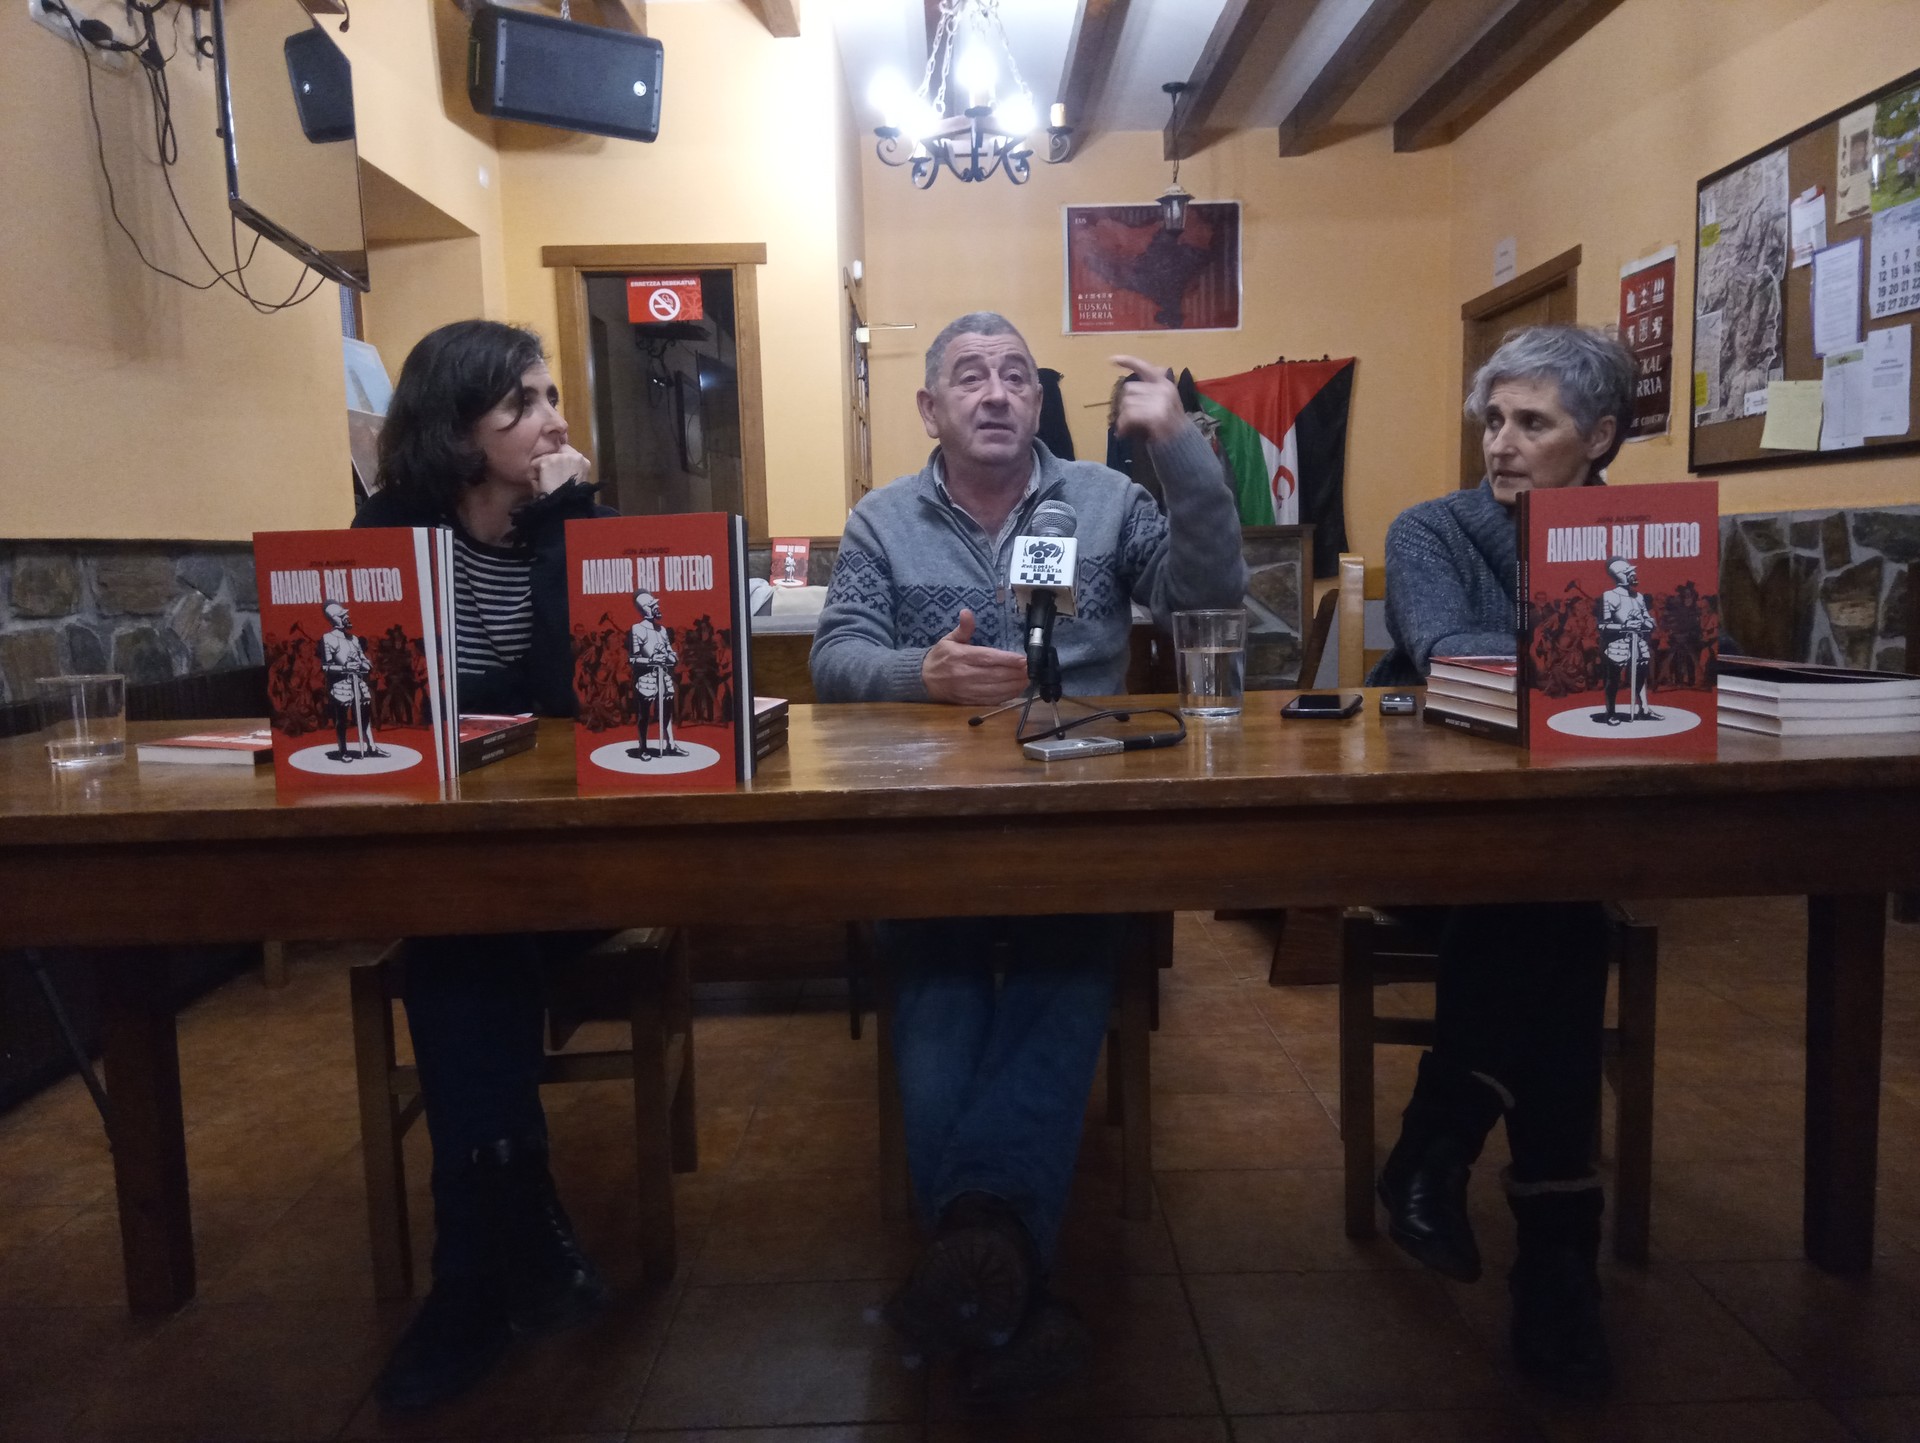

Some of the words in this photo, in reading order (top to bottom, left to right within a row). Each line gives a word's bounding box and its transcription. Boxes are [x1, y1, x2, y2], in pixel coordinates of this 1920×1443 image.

[1881, 255, 1886, 267] 5
[1892, 251, 1898, 264] 6
[1904, 248, 1910, 260] 7
[1879, 271, 1887, 282] 12
[1891, 267, 1898, 279] 13
[1902, 265, 1910, 275] 14
[1878, 286, 1886, 298] 19
[1889, 283, 1898, 295] 20
[1901, 279, 1909, 292] 21
[1912, 277, 1920, 289] 22
[1078, 303, 1113, 311] EUSKAL
[1876, 301, 1886, 314] 26
[1888, 298, 1897, 310] 27
[1898, 295, 1909, 308] 28
[1910, 292, 1920, 305] 29
[1079, 311, 1113, 319] HERRIA
[1637, 376, 1662, 397] RRIA
[1547, 526, 1607, 562] AMAIUR
[1612, 524, 1639, 559] BAT
[1644, 522, 1700, 558] URTERO
[582, 558, 634, 594] AMAIUR
[637, 556, 660, 592] BAT
[664, 555, 713, 592] URTERO
[270, 570, 322, 604] AMAIUR
[324, 569, 349, 602] BAT
[351, 567, 403, 602] URTERO
